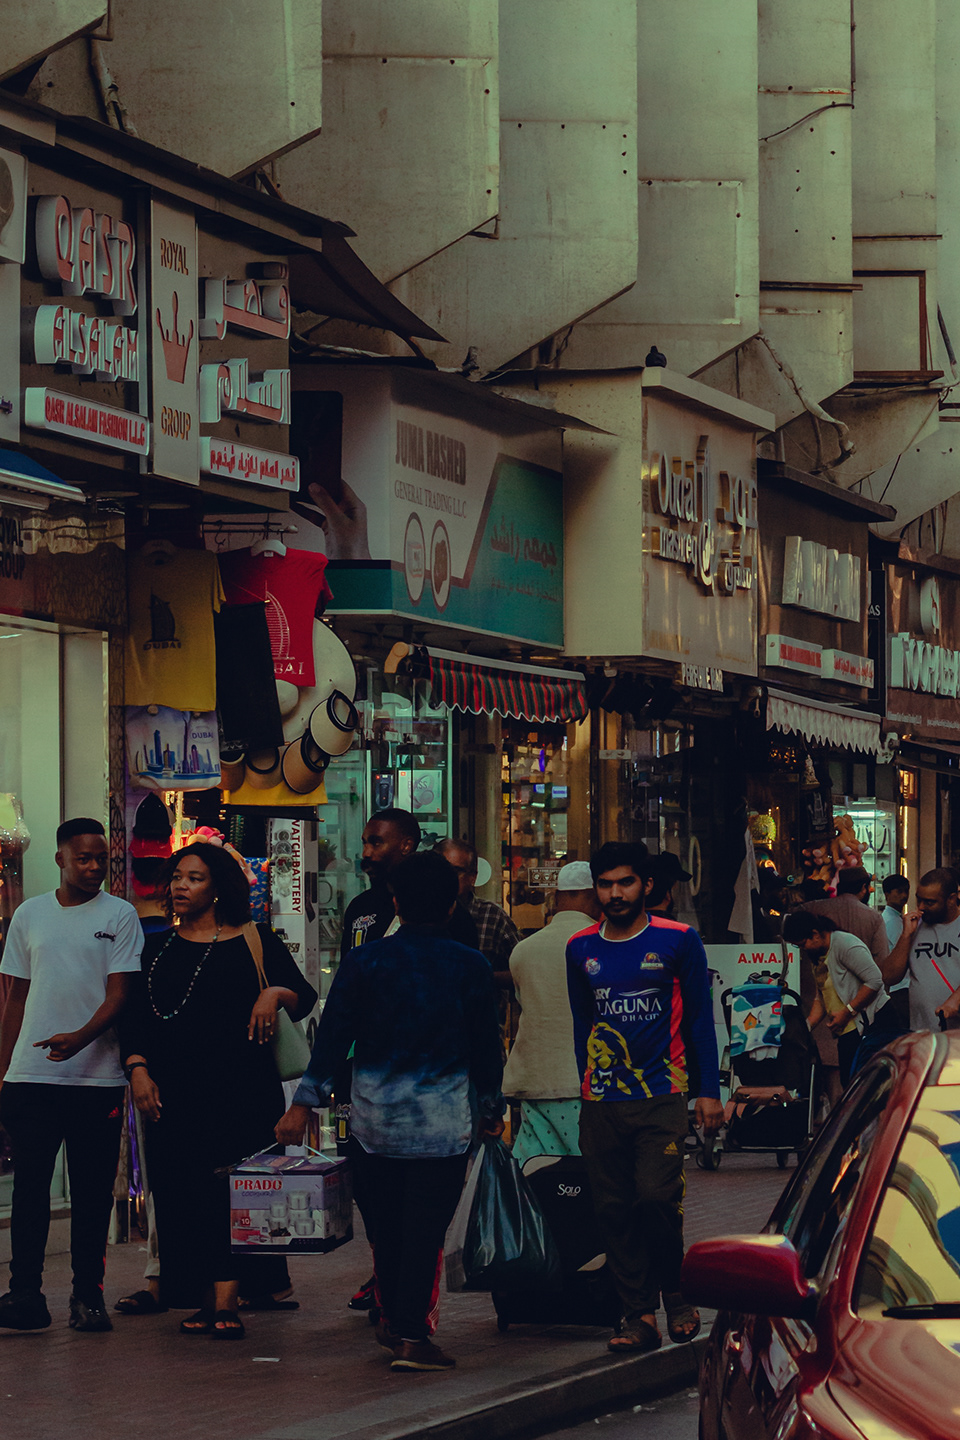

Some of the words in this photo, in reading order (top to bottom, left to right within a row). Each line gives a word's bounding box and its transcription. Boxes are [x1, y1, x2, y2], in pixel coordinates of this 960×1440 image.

[42, 195, 138, 316] QASR
[160, 238, 189, 276] ROYAL
[40, 305, 139, 382] ALSALAM
[45, 395, 65, 423] QASR
[66, 401, 98, 433] ALSALAM
[99, 411, 128, 441] FASHION
[161, 405, 191, 441] GROUP
[395, 419, 425, 472] JUMA
[426, 430, 466, 486] RASHED
[395, 479, 423, 506] GENERAL
[424, 488, 452, 514] TRADING
[143, 641, 182, 651] DUBAI
[274, 661, 305, 676] BAI
[292, 861, 301, 913] BATTERY
[596, 997, 662, 1016] LAGUNA
[234, 1179, 283, 1191] PRADO
